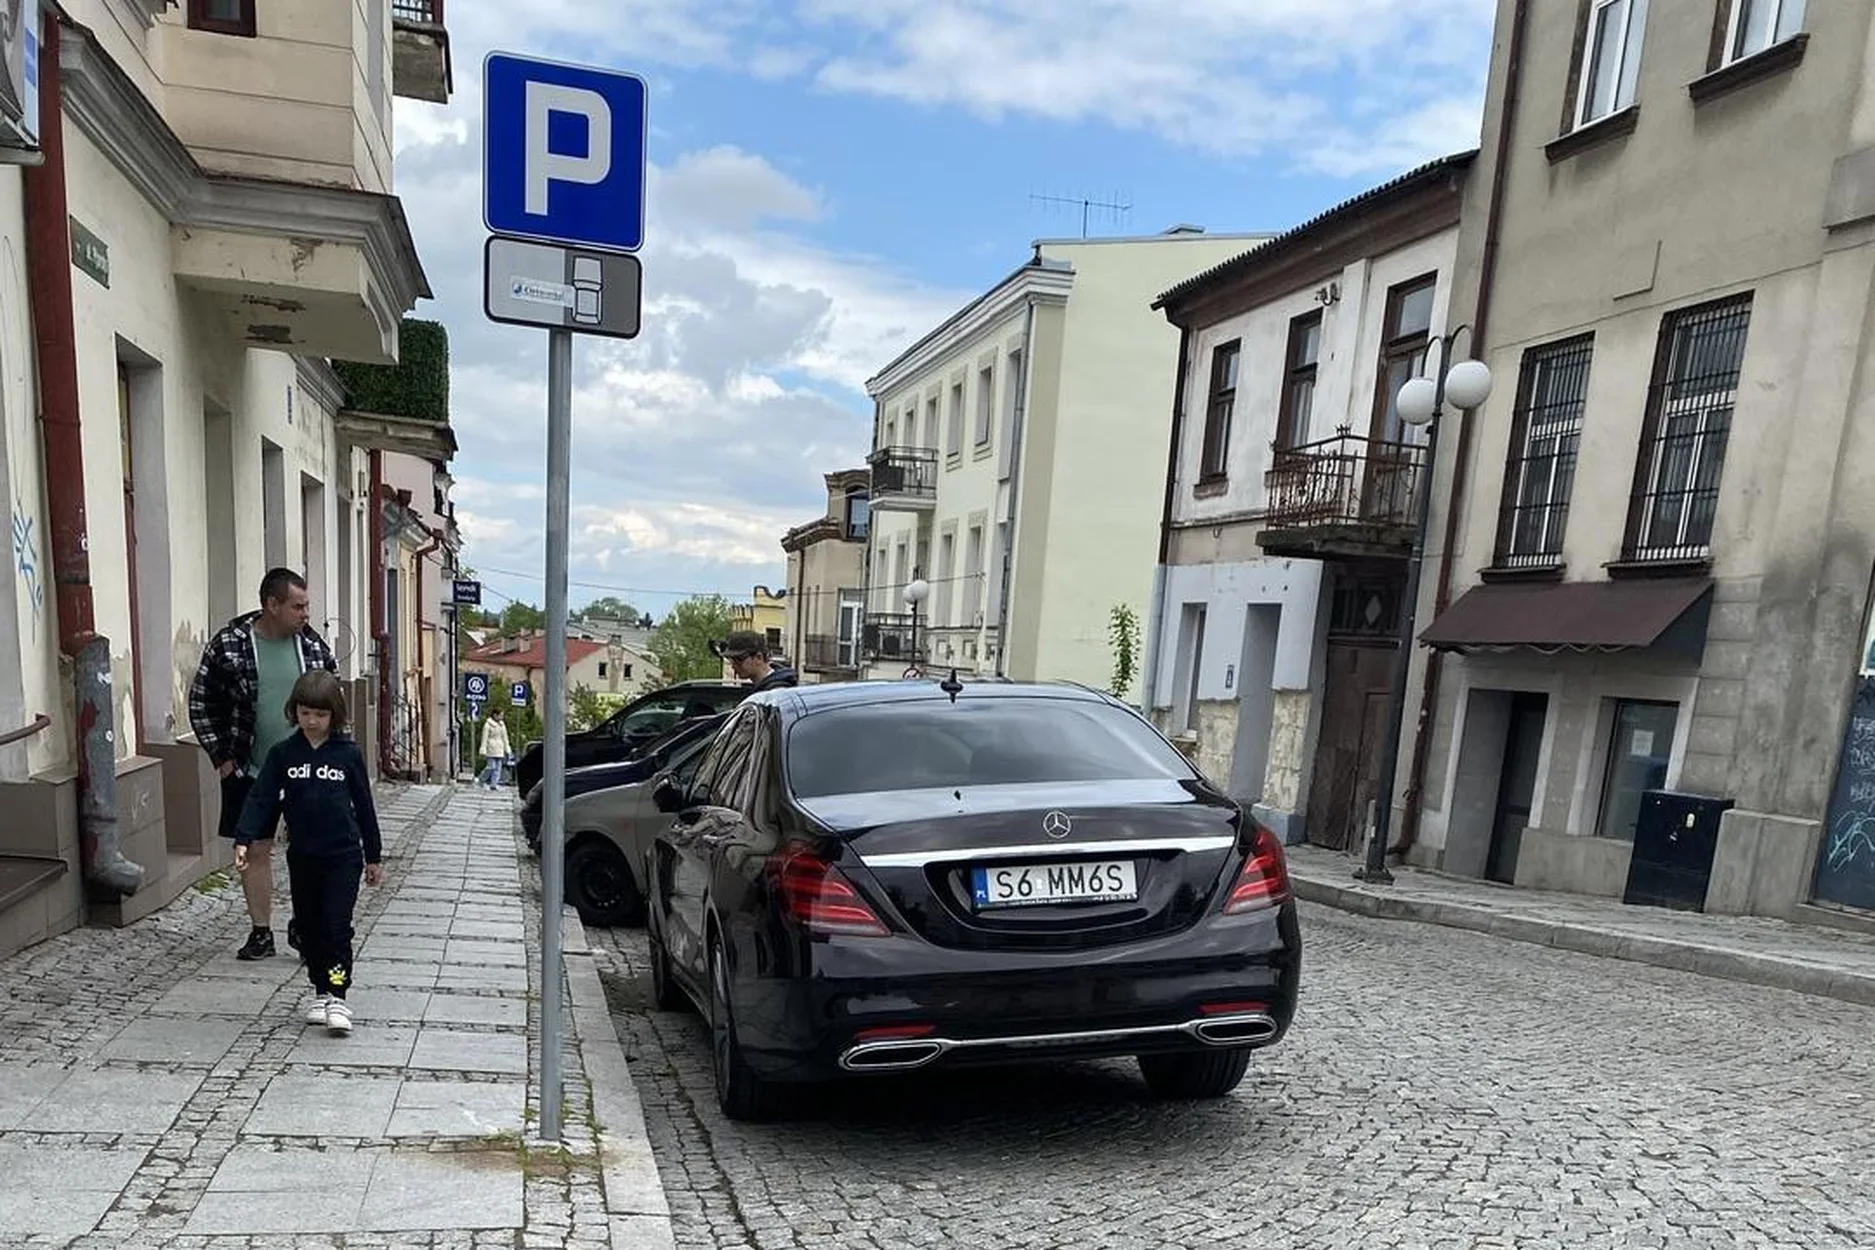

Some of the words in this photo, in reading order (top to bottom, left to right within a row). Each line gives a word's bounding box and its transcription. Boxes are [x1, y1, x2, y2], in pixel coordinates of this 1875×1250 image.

[525, 80, 612, 216] P
[514, 684, 524, 697] P
[996, 868, 1033, 898] S6
[1047, 864, 1123, 896] MM6S
